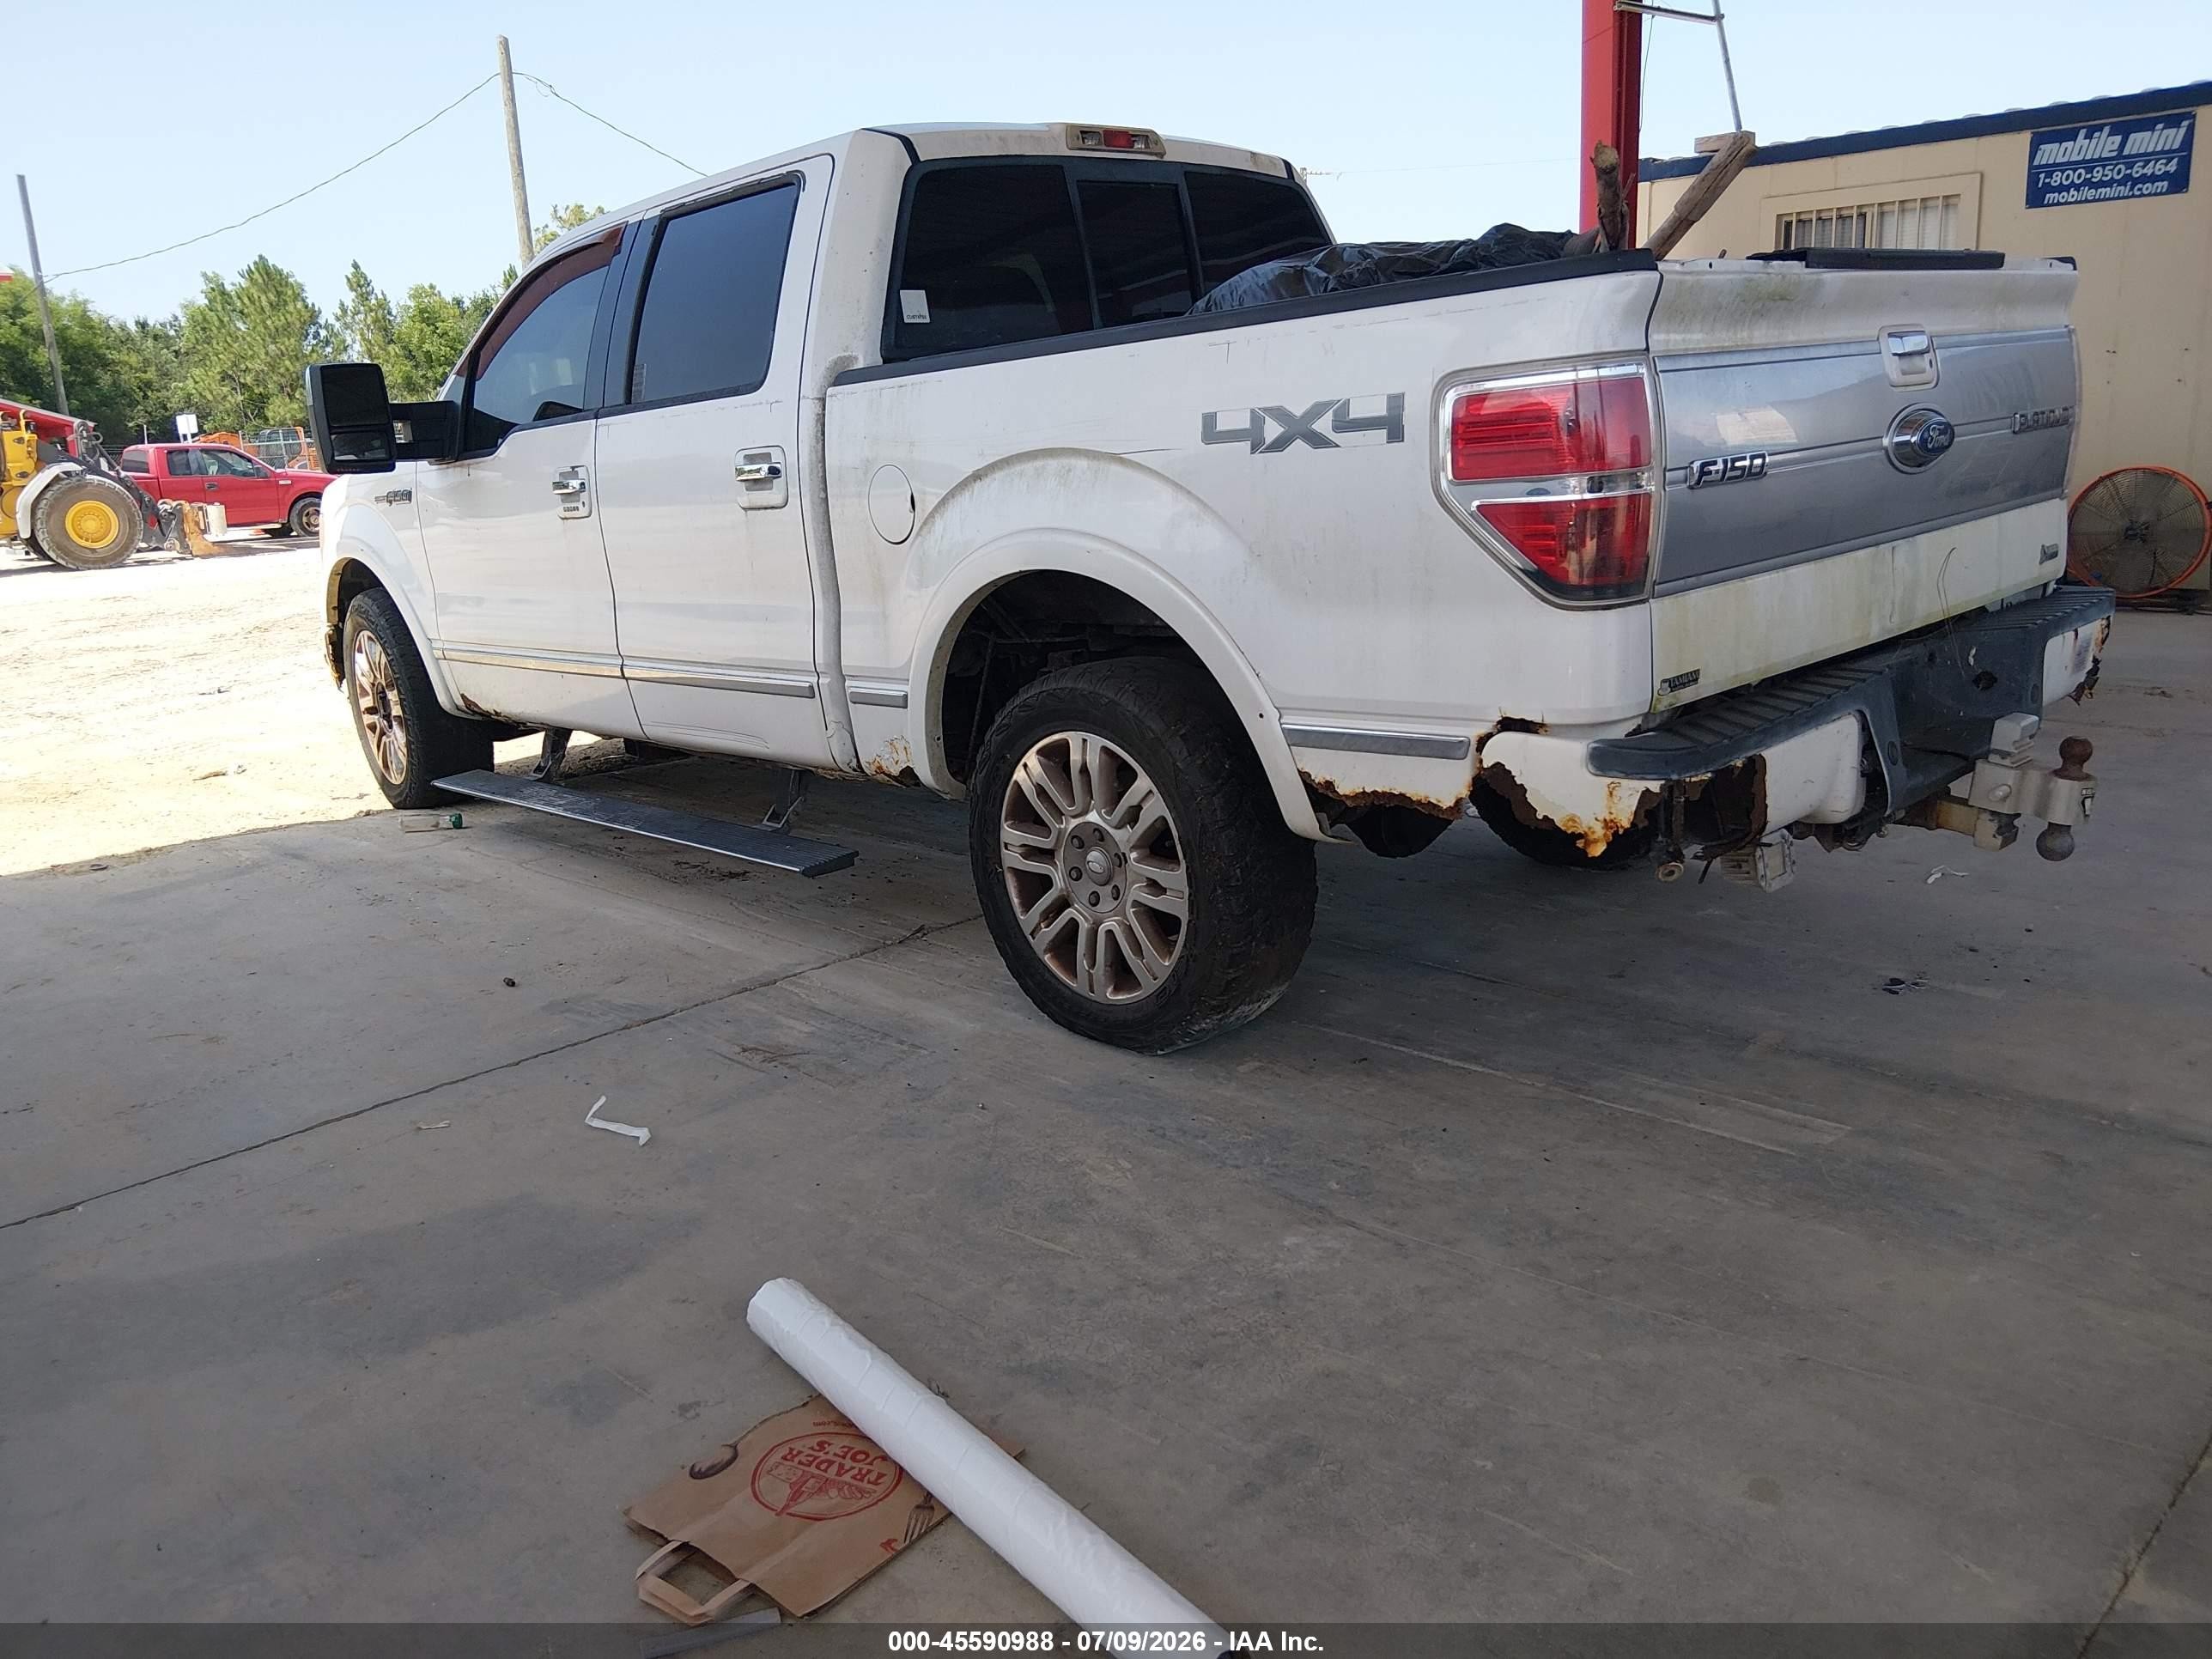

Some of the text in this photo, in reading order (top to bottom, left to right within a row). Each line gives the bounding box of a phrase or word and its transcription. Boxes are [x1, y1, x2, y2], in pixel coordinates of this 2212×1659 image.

[2033, 119, 2194, 166] mobile mini
[2037, 157, 2179, 188] 1-800-950-6464
[2043, 180, 2169, 205] mobilemini.com
[781, 1446, 888, 1486] TRADER
[808, 1439, 890, 1467] JOE'S
